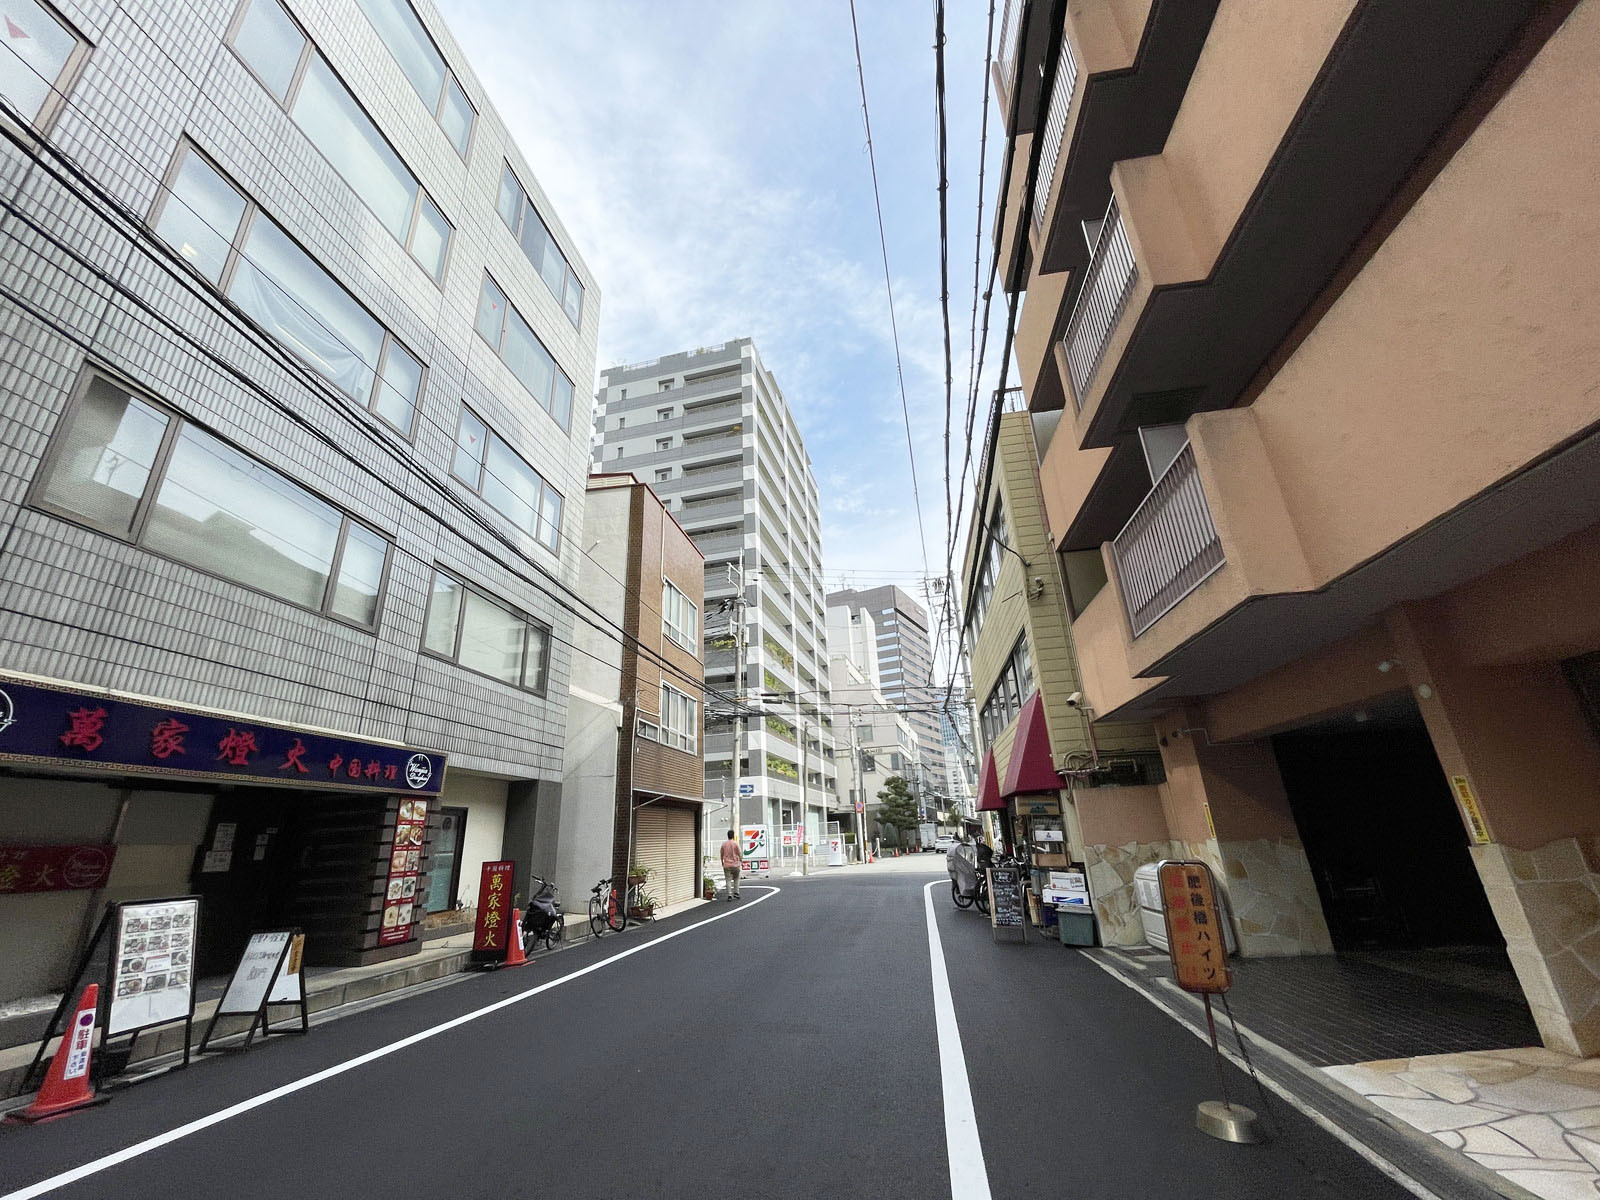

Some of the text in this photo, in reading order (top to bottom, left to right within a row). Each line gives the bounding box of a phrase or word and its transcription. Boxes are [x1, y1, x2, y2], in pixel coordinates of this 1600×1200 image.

[60, 706, 397, 781] 萬家燈火 中国料理
[483, 873, 504, 947] 萬家燈火
[1187, 875, 1216, 980] 肥後橋ハイツ
